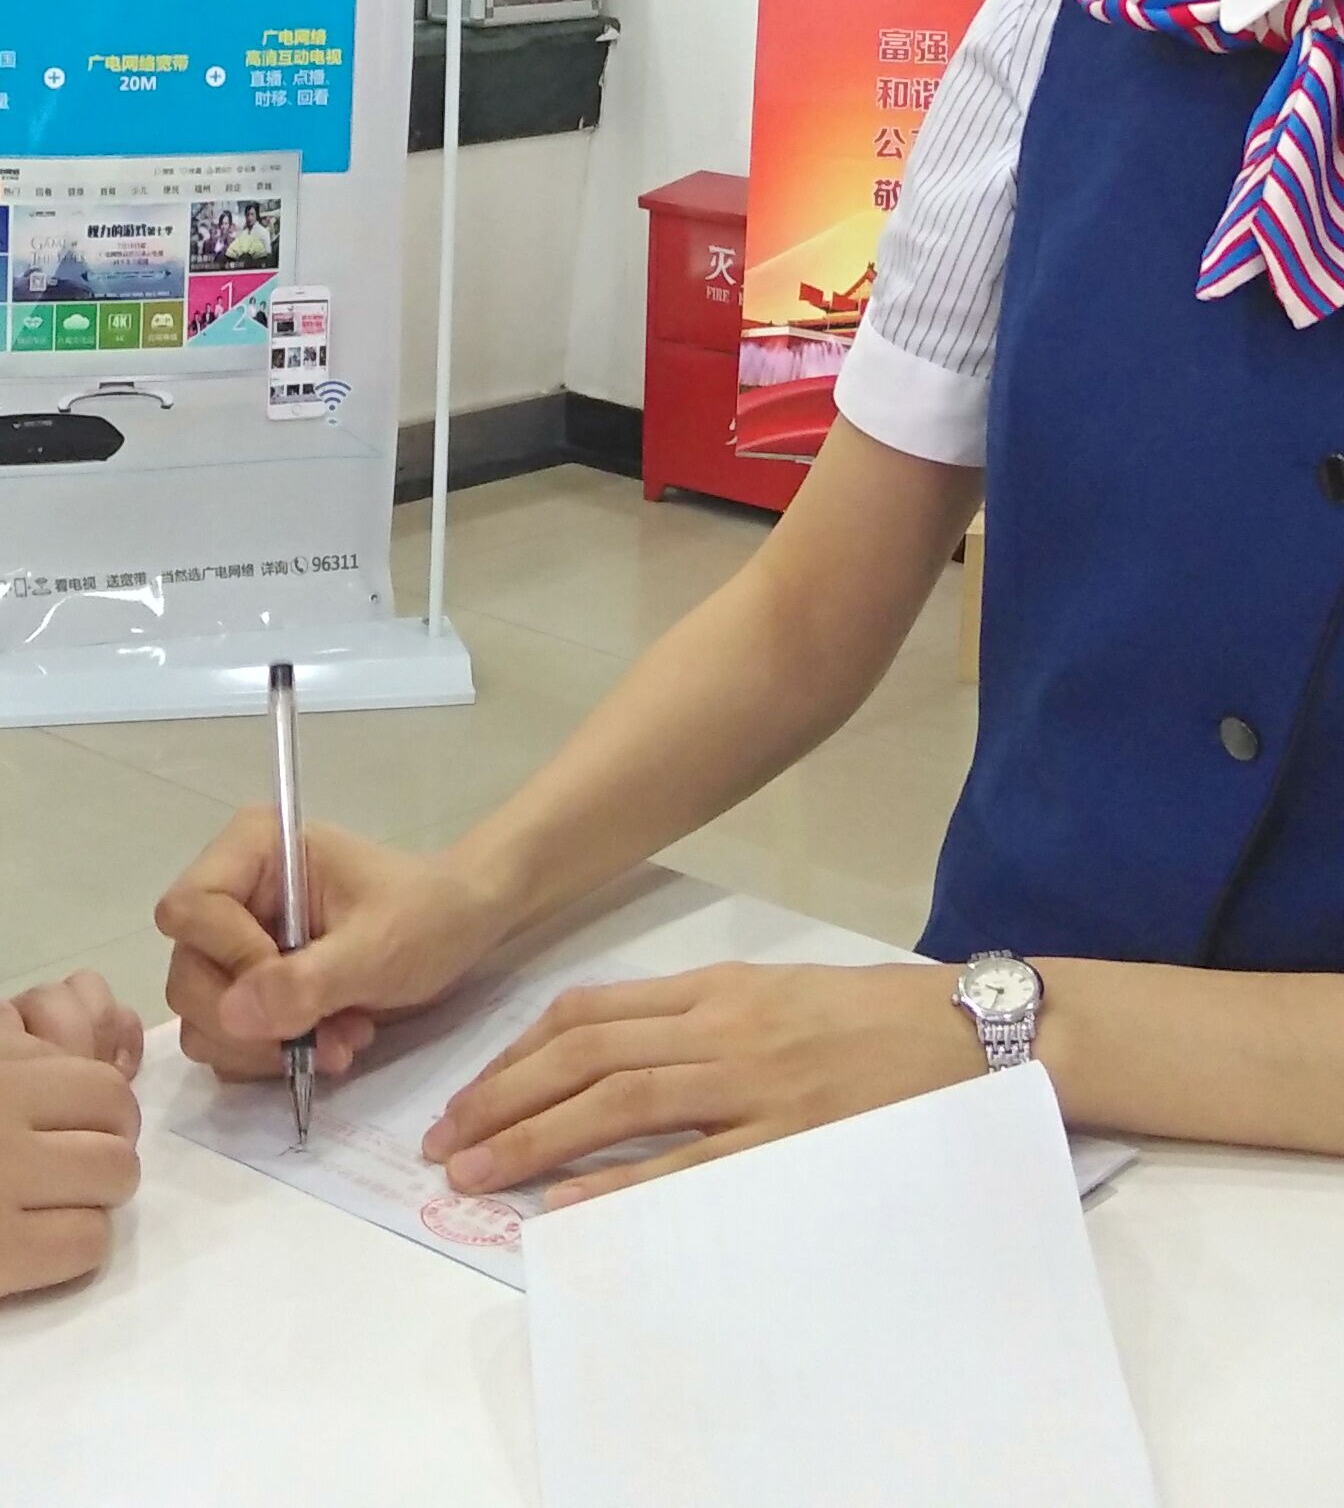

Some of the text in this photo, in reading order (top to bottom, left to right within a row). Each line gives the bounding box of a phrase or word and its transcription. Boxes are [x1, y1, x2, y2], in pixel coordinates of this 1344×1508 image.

[262, 28, 327, 47] 广电网络
[878, 27, 949, 65] 富强
[88, 54, 190, 74] 广电网络宽带
[245, 47, 343, 67] 高清互动电视
[119, 75, 158, 92] 20M
[873, 127, 920, 161] 公
[706, 285, 731, 304] FIRE
[55, 553, 360, 593] 看电视 送宽带 当然选广电网络 详询 96311
